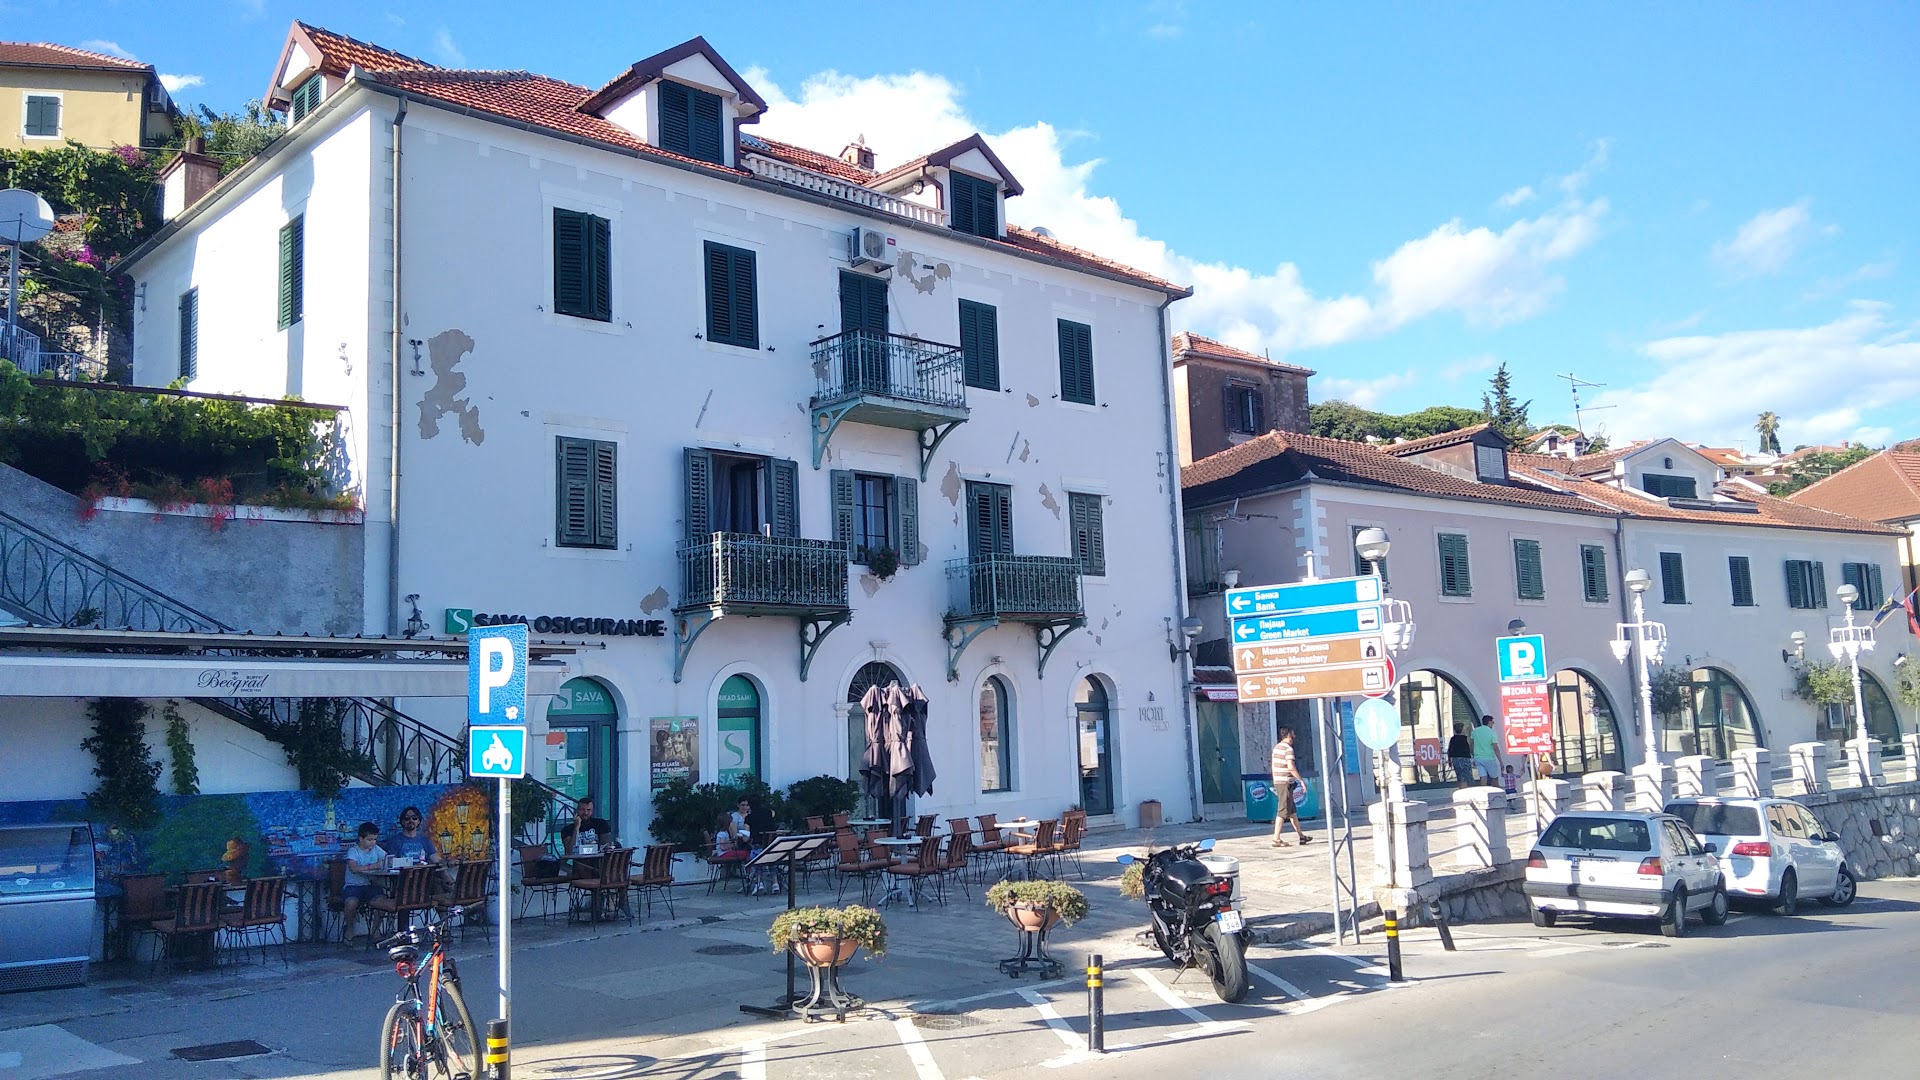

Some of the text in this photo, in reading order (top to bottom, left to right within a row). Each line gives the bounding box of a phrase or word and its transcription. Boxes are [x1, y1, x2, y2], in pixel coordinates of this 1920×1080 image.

[1255, 592, 1280, 600] Банка
[1256, 602, 1276, 611] Bank
[534, 615, 665, 636] OSIGURANJE
[1259, 620, 1285, 630] Пијаца
[1260, 628, 1310, 639] Green Market
[1262, 643, 1330, 656] Манастир Савина
[1263, 654, 1328, 667] Savina Monastery
[479, 637, 514, 714] P
[1265, 675, 1306, 686] Стари град
[197, 669, 270, 696] Beograd
[575, 691, 604, 702] SAVA
[1266, 686, 1297, 696] Old Town
[1510, 687, 1533, 696] ZONA
[1421, 743, 1441, 761] 50%
